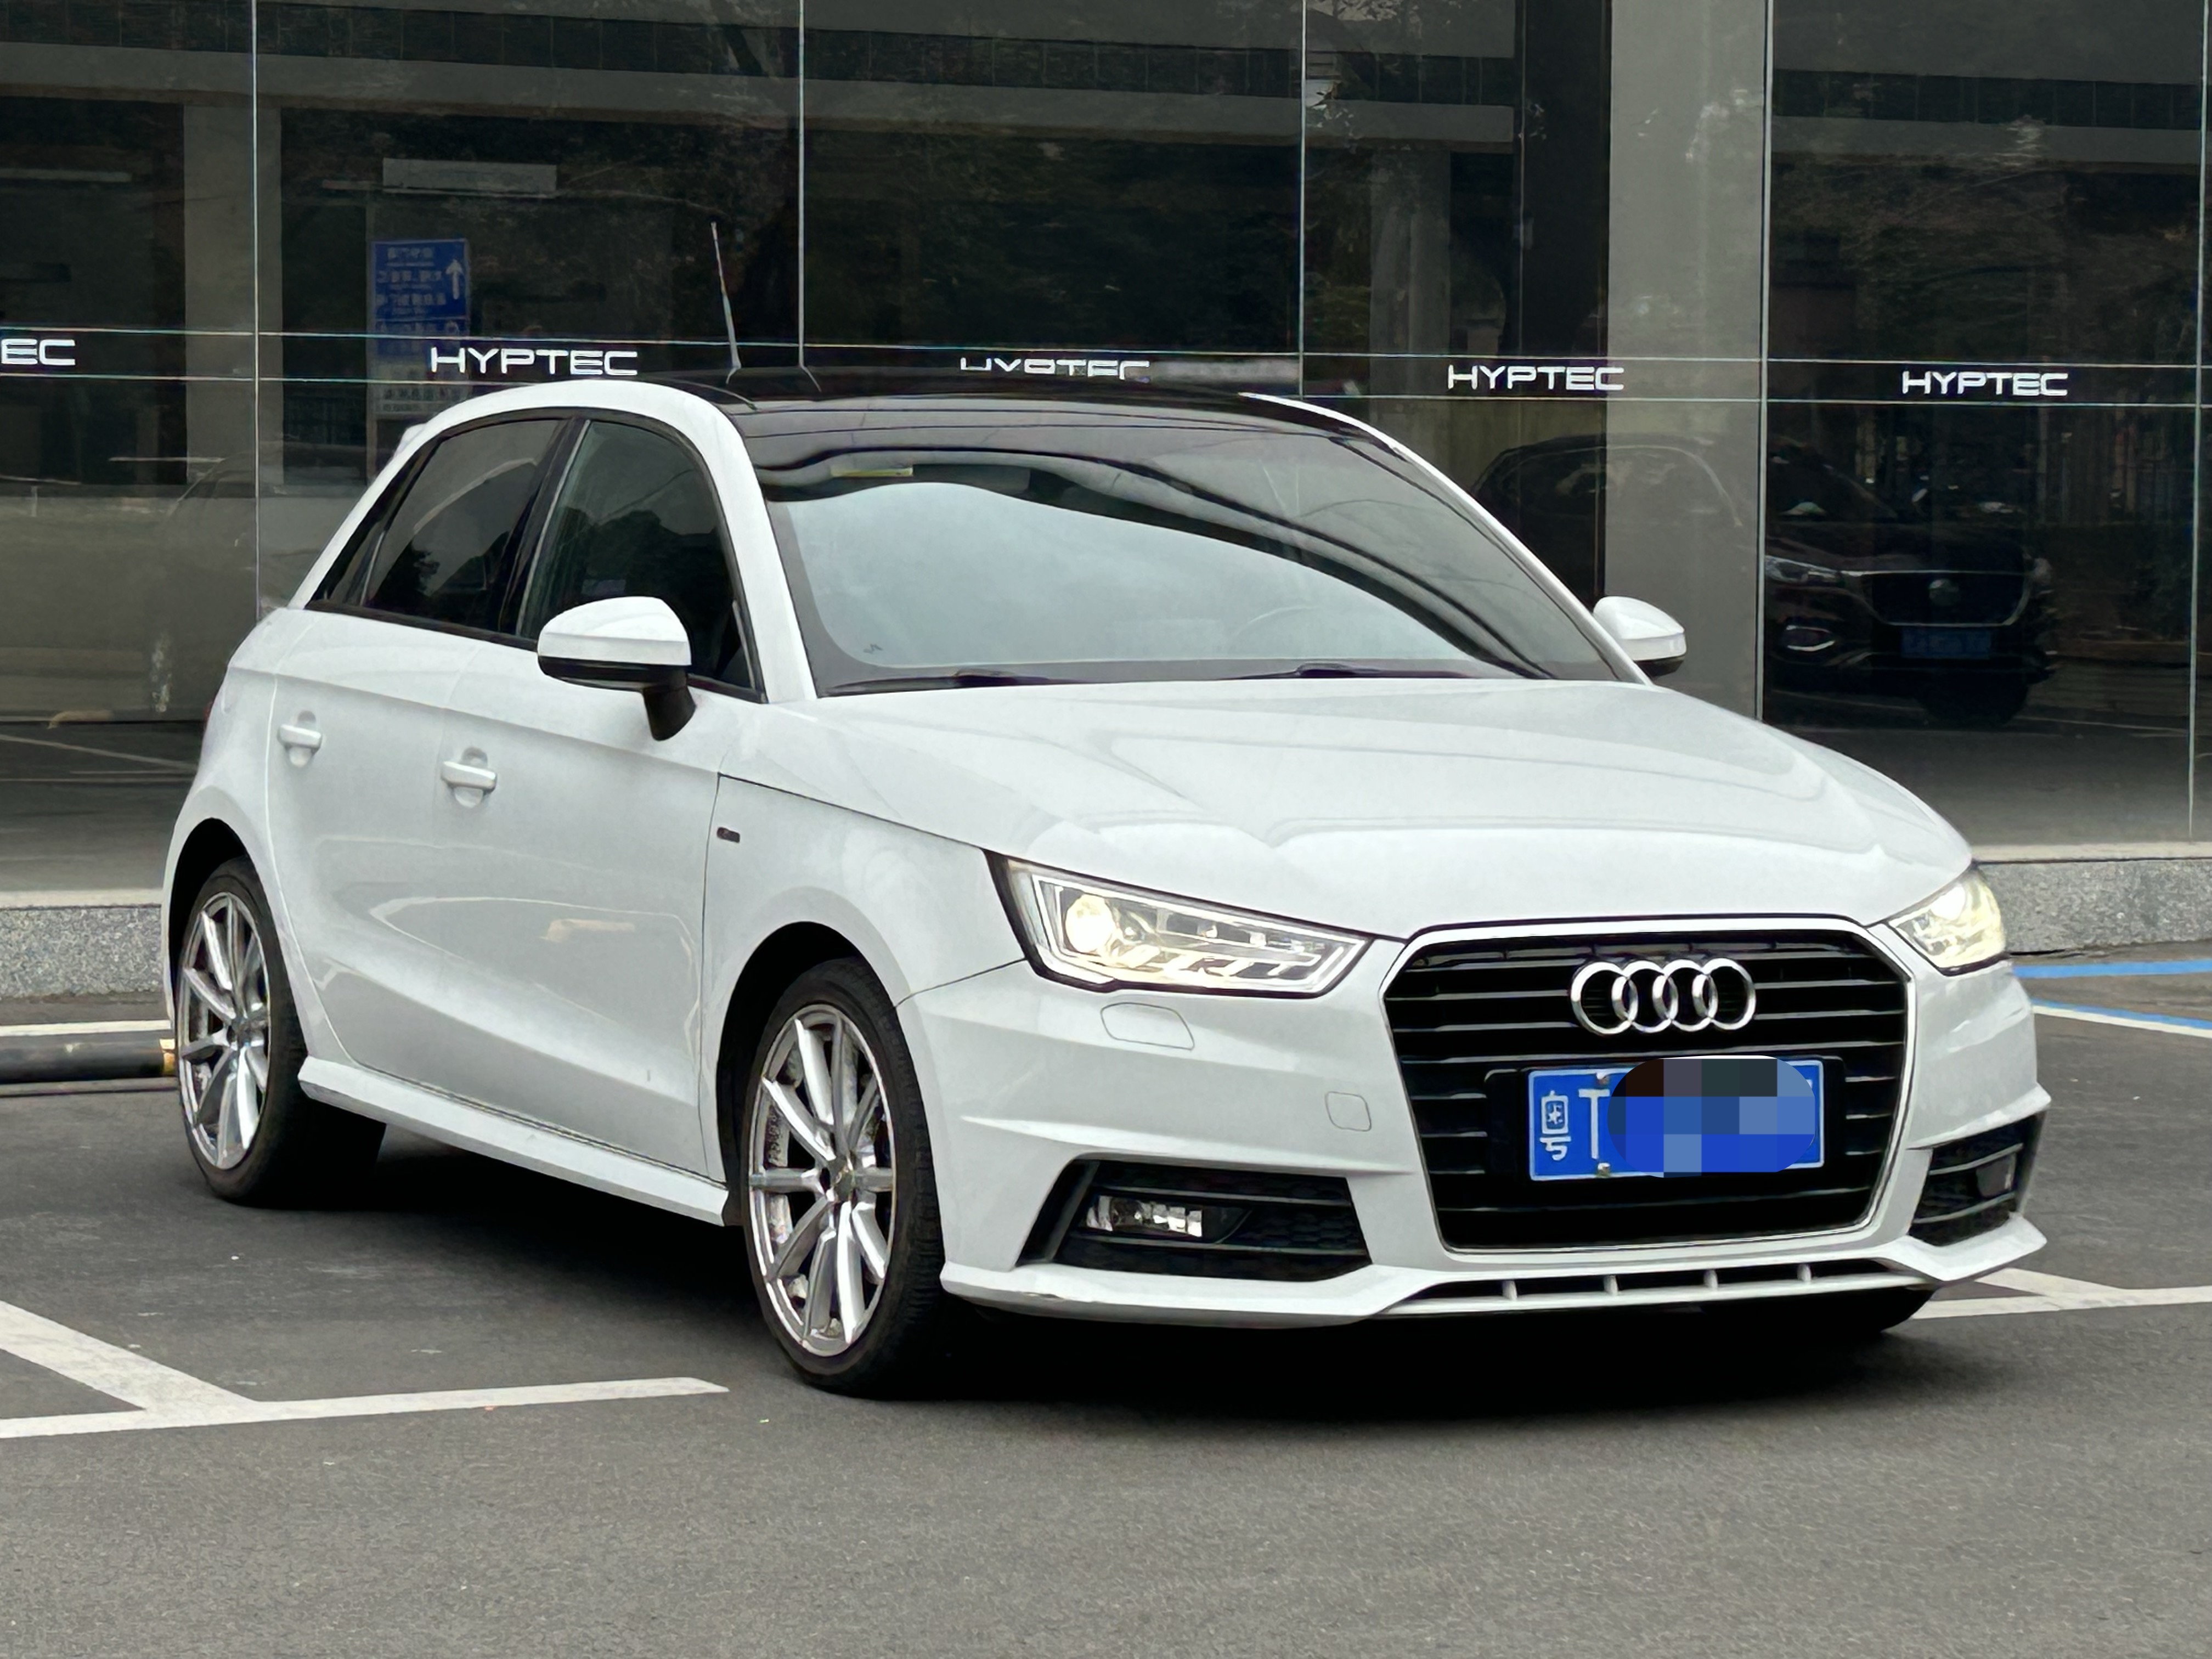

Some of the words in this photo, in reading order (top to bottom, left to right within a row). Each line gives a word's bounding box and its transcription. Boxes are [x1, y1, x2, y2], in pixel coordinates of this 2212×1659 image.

[430, 346, 638, 376] HYPTEC
[1448, 364, 1625, 391] HYPTEC
[1901, 370, 2068, 396] HYPTEC
